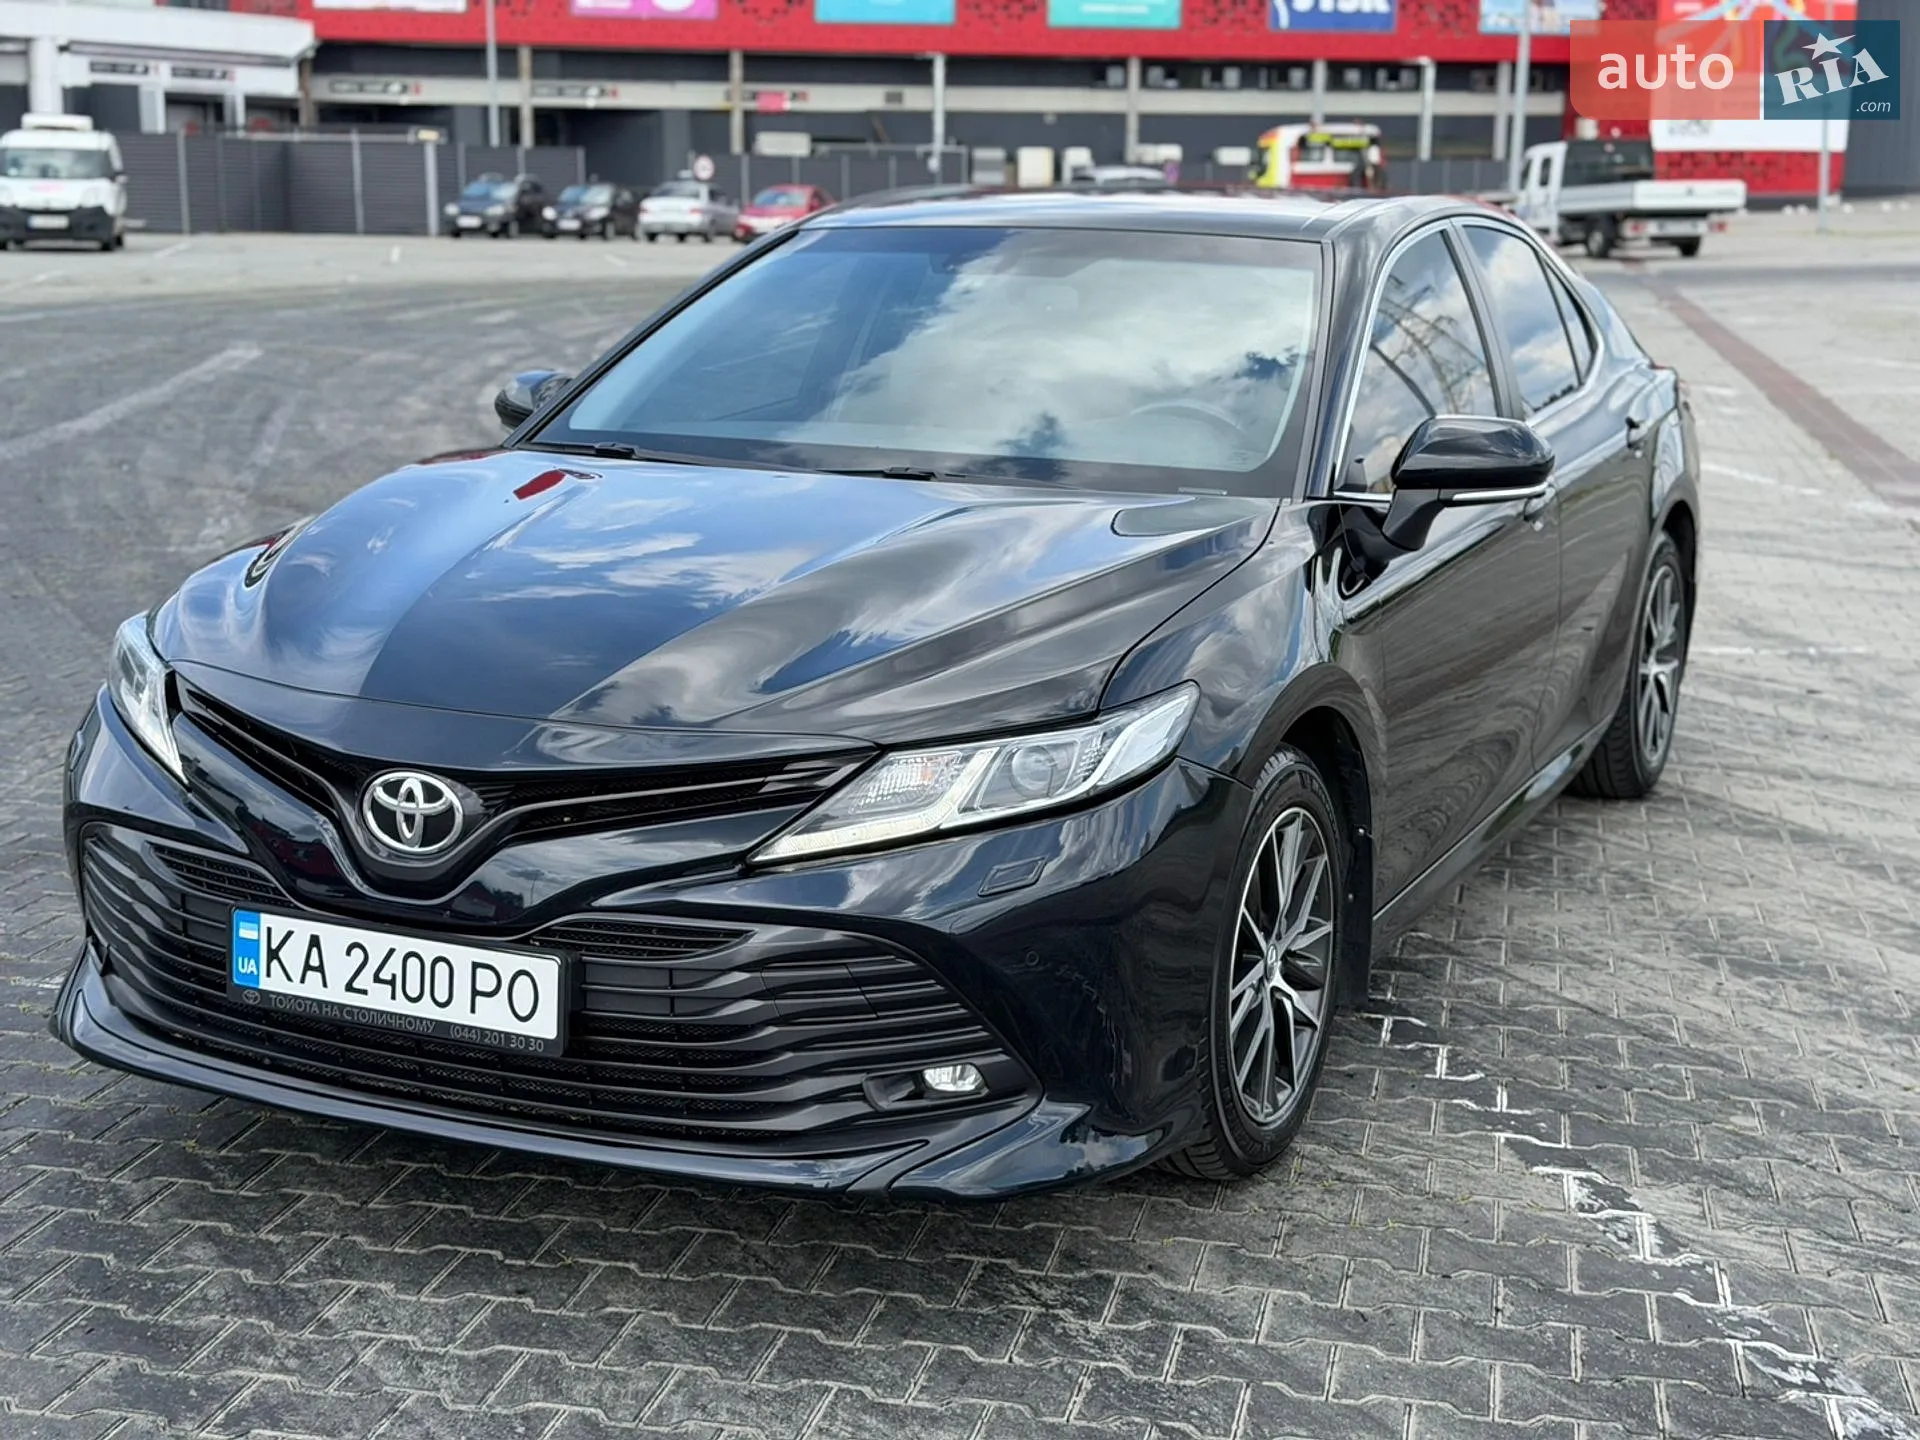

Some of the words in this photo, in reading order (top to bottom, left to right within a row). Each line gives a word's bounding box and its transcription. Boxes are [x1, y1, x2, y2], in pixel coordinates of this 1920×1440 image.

[238, 957, 258, 976] UA
[265, 926, 328, 988] KA
[345, 941, 454, 1009] 2400
[470, 961, 539, 1023] PO
[269, 993, 320, 1015] ТОЙОТА
[322, 1003, 341, 1018] НА
[343, 1006, 436, 1033] СТОЛИЧНОМУ
[450, 1023, 480, 1042] (044)
[484, 1031, 505, 1047] 201
[510, 1035, 525, 1049] 30
[529, 1038, 544, 1053] 30
